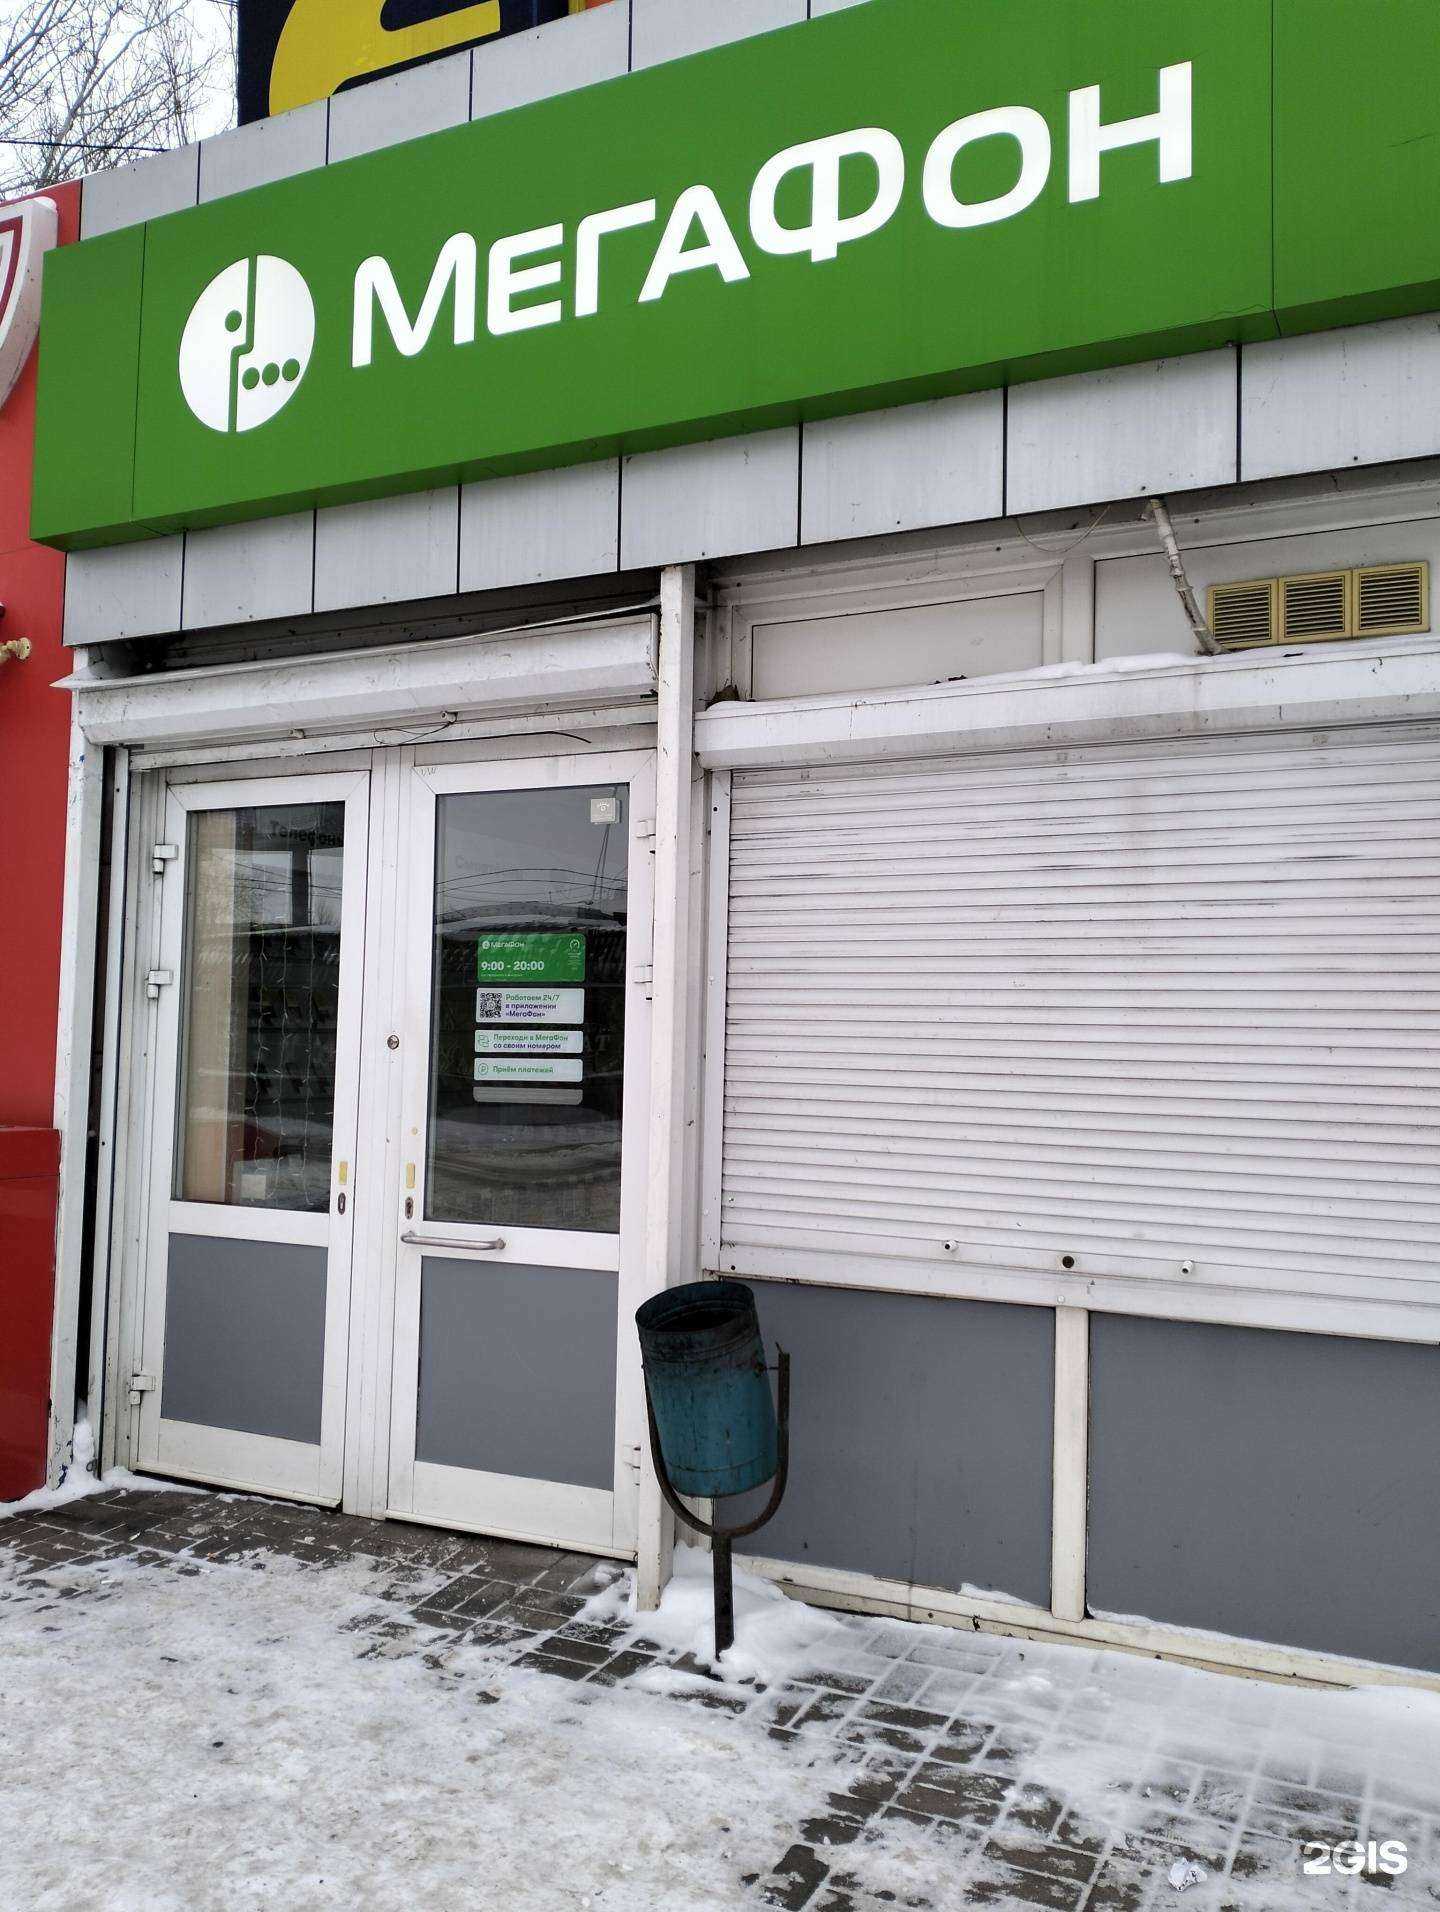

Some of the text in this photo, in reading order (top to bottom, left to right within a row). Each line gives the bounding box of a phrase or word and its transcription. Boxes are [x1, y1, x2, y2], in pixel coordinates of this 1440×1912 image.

[481, 961, 505, 971] 9:00
[513, 961, 545, 971] 20:00
[505, 993, 541, 1001] Работаем
[493, 1034, 528, 1042] Переходи
[527, 1043, 561, 1051] номером
